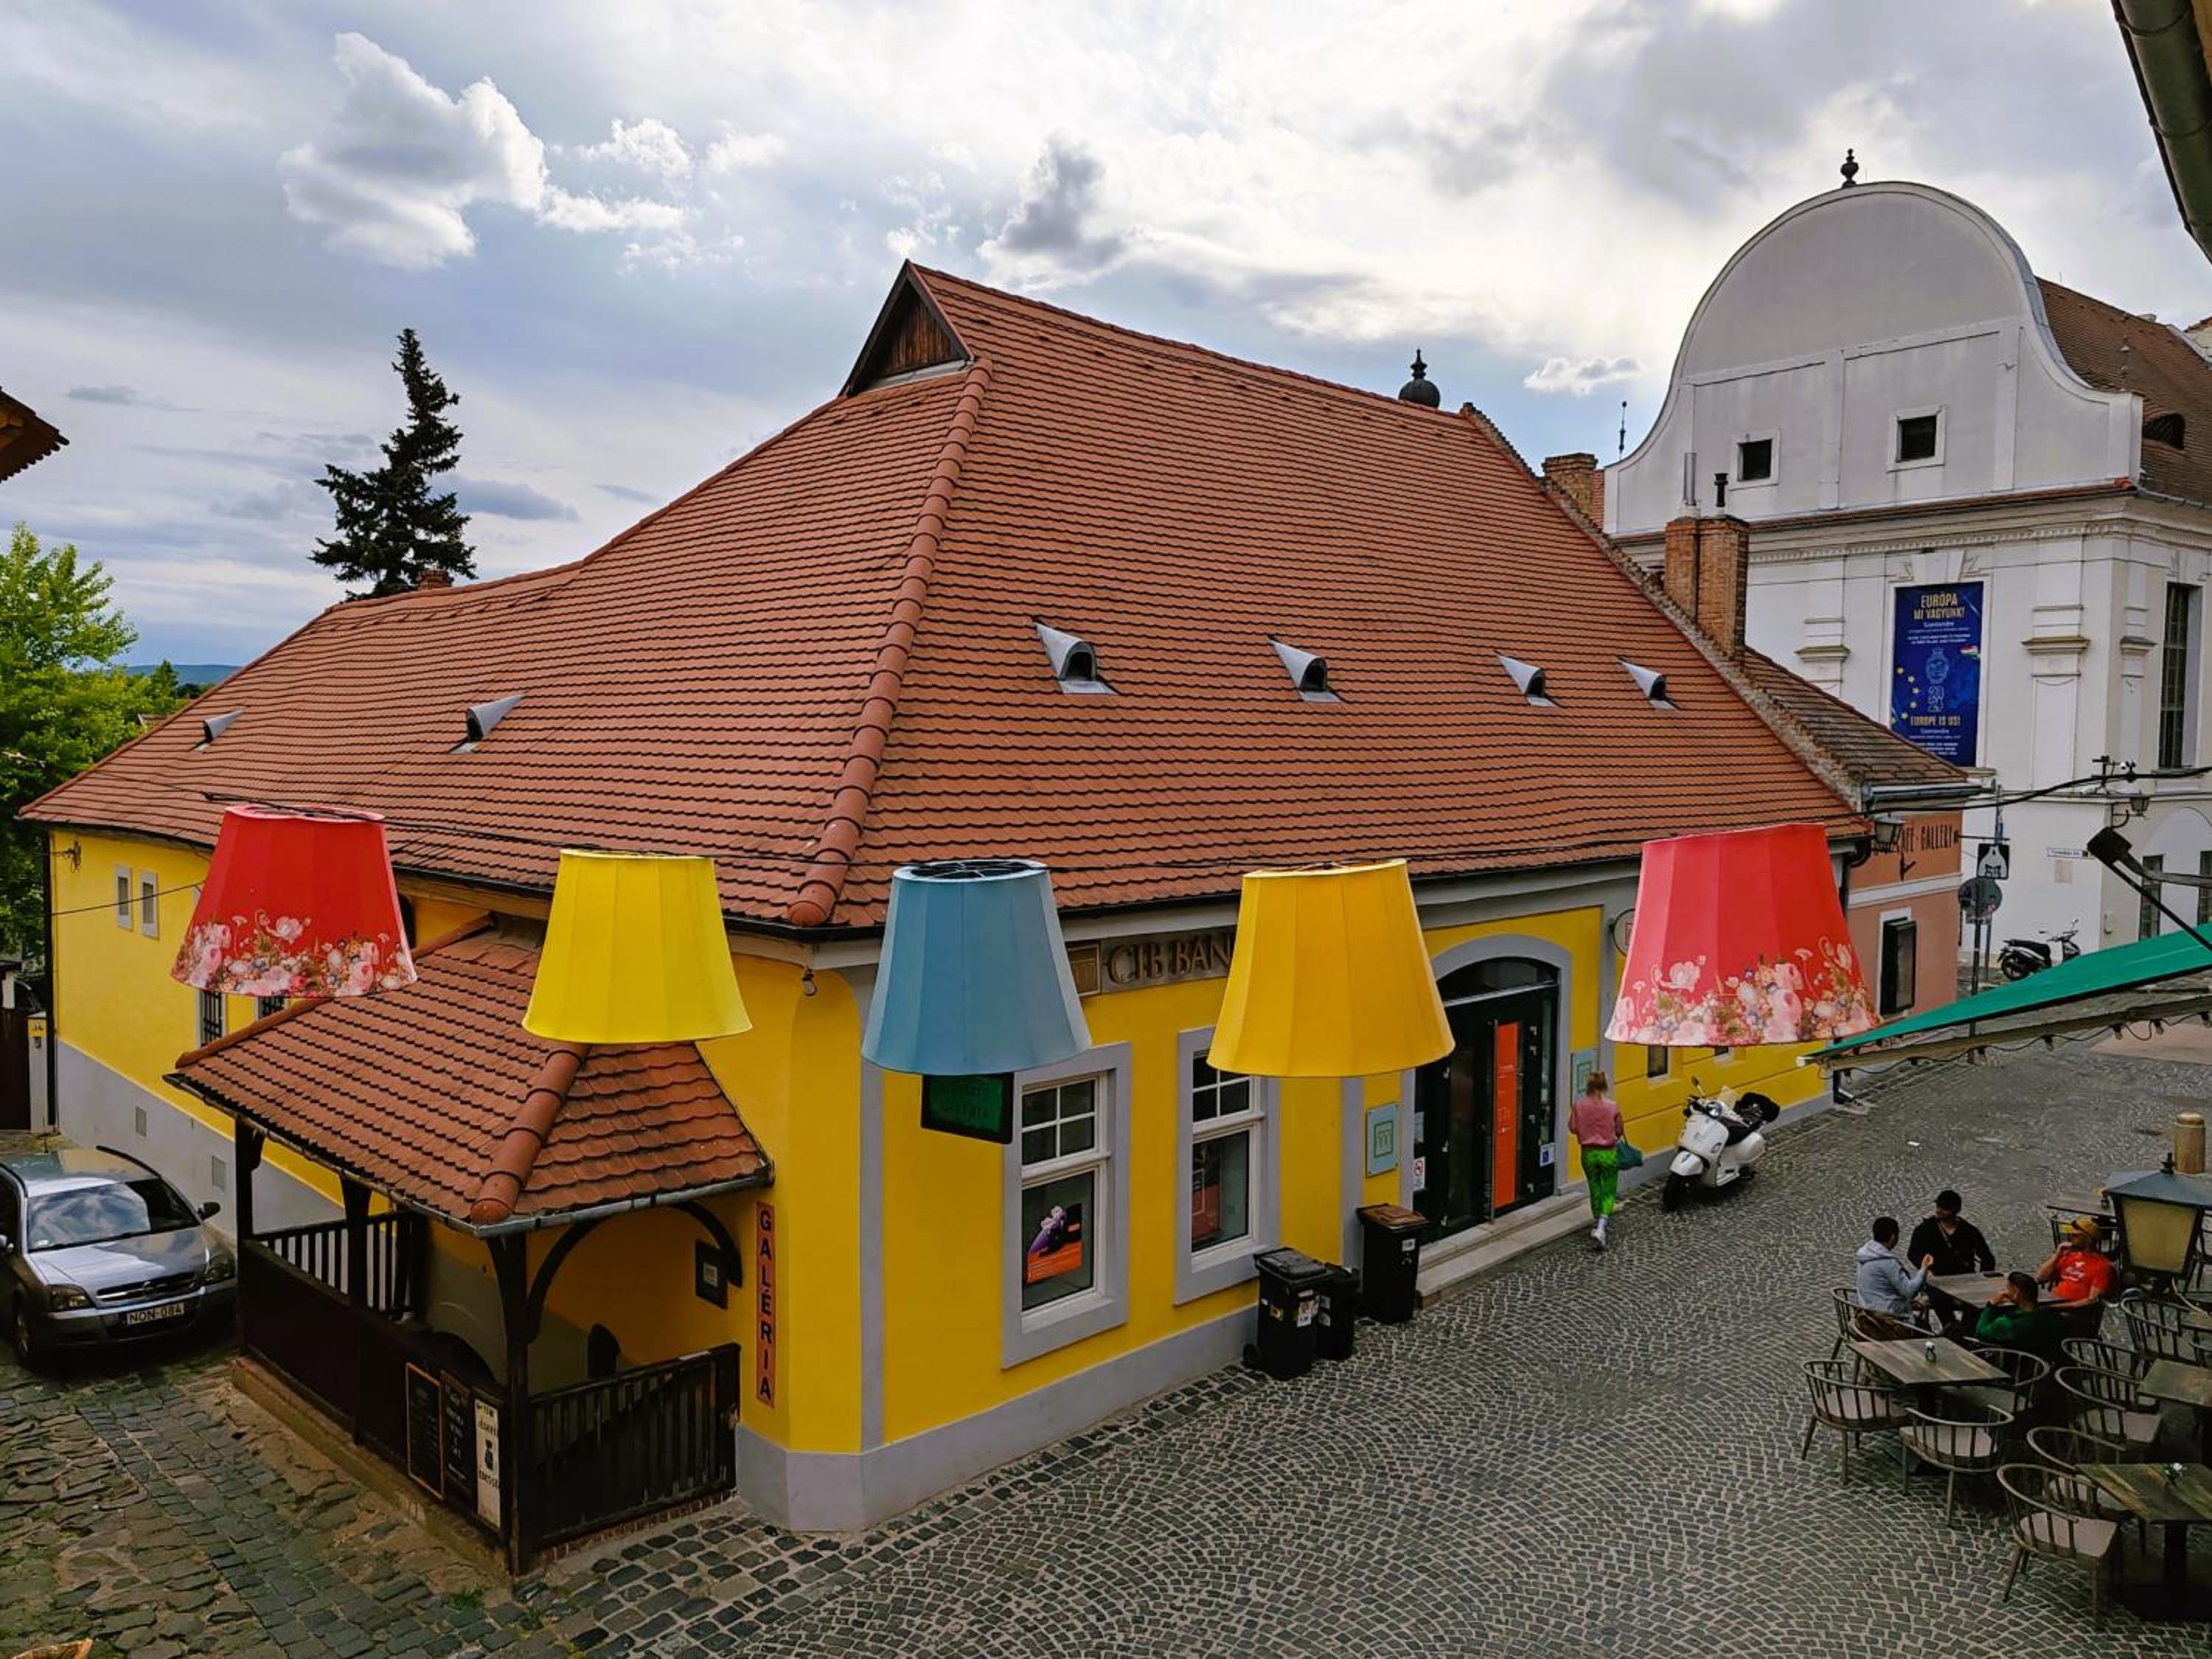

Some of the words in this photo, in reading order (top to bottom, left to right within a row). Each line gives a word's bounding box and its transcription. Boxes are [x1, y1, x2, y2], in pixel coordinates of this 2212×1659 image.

[1910, 715, 1935, 726] EUROPE
[1938, 715, 1946, 726] IS
[1921, 823, 1952, 852] GALLERY
[1108, 942, 1166, 984] CIB
[1171, 933, 1232, 979] BAN
[760, 1209, 773, 1399] GALÉRIA
